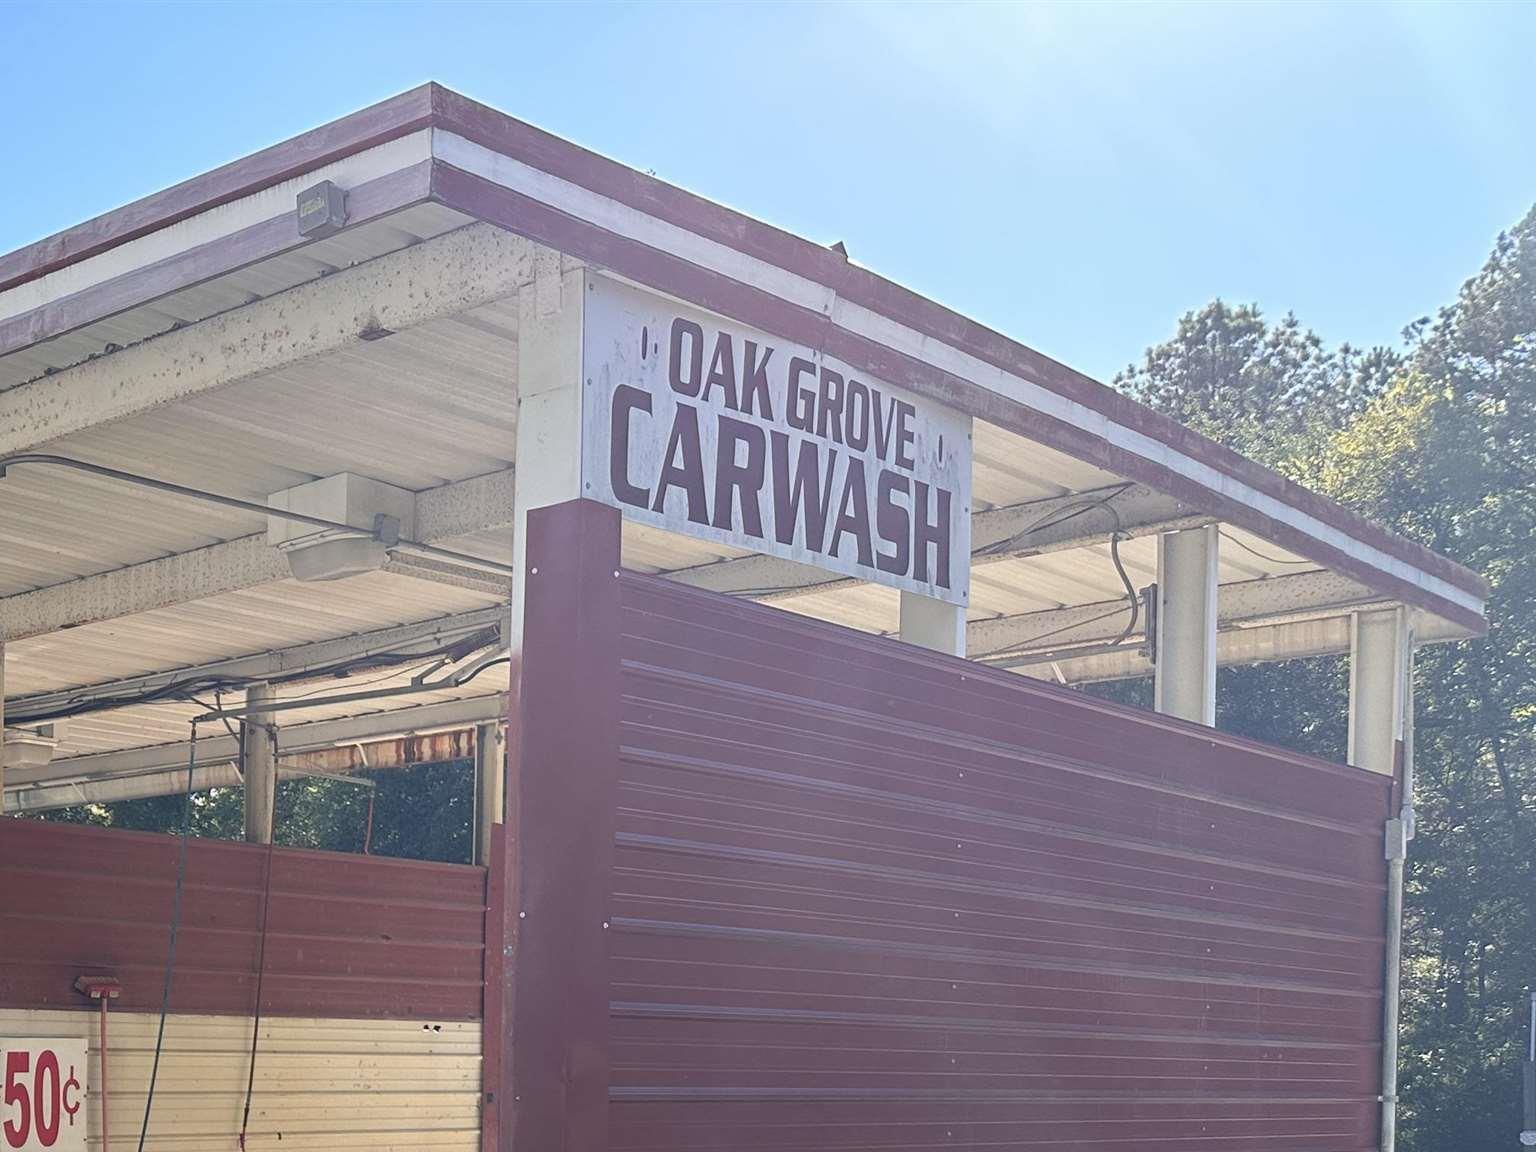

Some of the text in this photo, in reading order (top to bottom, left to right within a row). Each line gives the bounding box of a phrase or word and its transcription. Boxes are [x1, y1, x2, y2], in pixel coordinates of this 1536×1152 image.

[669, 317, 916, 471] OAK GROVE
[610, 384, 952, 589] CARWASH
[3, 1049, 81, 1149] 50¢
